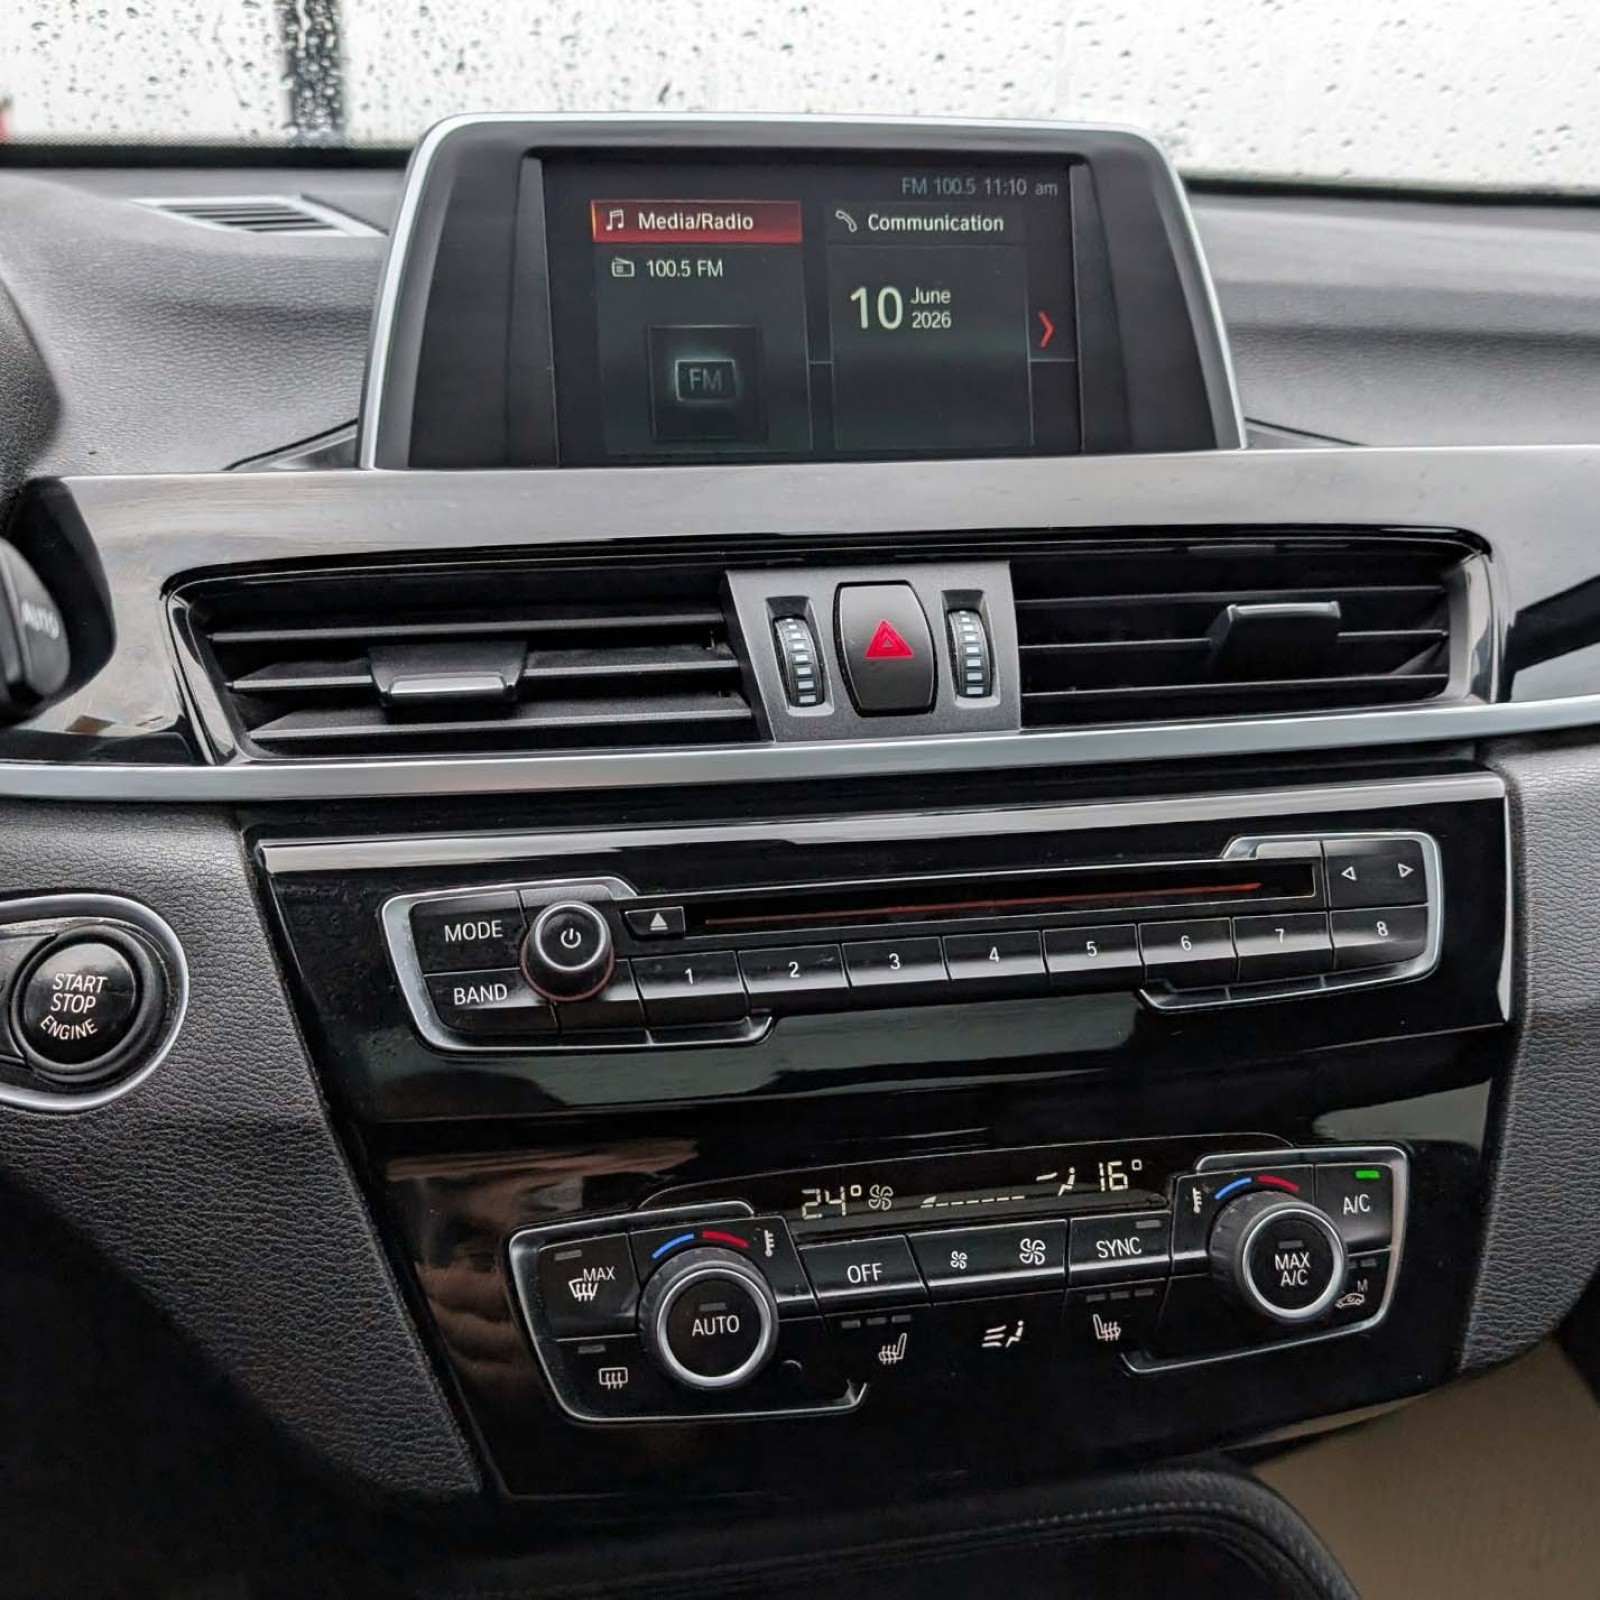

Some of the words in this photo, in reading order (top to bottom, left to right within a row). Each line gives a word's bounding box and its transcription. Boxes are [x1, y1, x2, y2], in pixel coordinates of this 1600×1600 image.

[902, 178, 928, 195] FM
[934, 178, 977, 195] 100.5
[984, 178, 1028, 195] 11:10
[1035, 182, 1059, 196] am
[637, 211, 755, 232] Media/Radio
[867, 212, 1005, 234] Communication
[646, 259, 691, 278] 100.5
[697, 259, 724, 278] FM
[911, 287, 952, 305] June
[850, 286, 904, 330] 10
[911, 311, 953, 329] 2026
[689, 369, 722, 390] FM
[444, 920, 504, 944] MODE
[683, 967, 696, 986] 1
[787, 961, 802, 979] 2
[888, 952, 902, 972] 3
[988, 945, 1001, 964] 4
[1085, 940, 1099, 958] 5
[1179, 934, 1193, 953] 6
[1274, 928, 1287, 944] 7
[1377, 920, 1390, 938] 8
[53, 973, 108, 993] START
[51, 993, 96, 1013] STOP
[453, 983, 508, 1006] BAND
[40, 1015, 98, 1040] ENGINE
[1342, 1194, 1371, 1215] A/C
[1096, 1237, 1142, 1258] SYNC
[1274, 1252, 1311, 1270] MAX
[583, 1266, 616, 1282] MAX
[847, 1262, 883, 1284] OFF
[1280, 1269, 1309, 1287] A/C
[691, 1314, 740, 1337] AUTO
